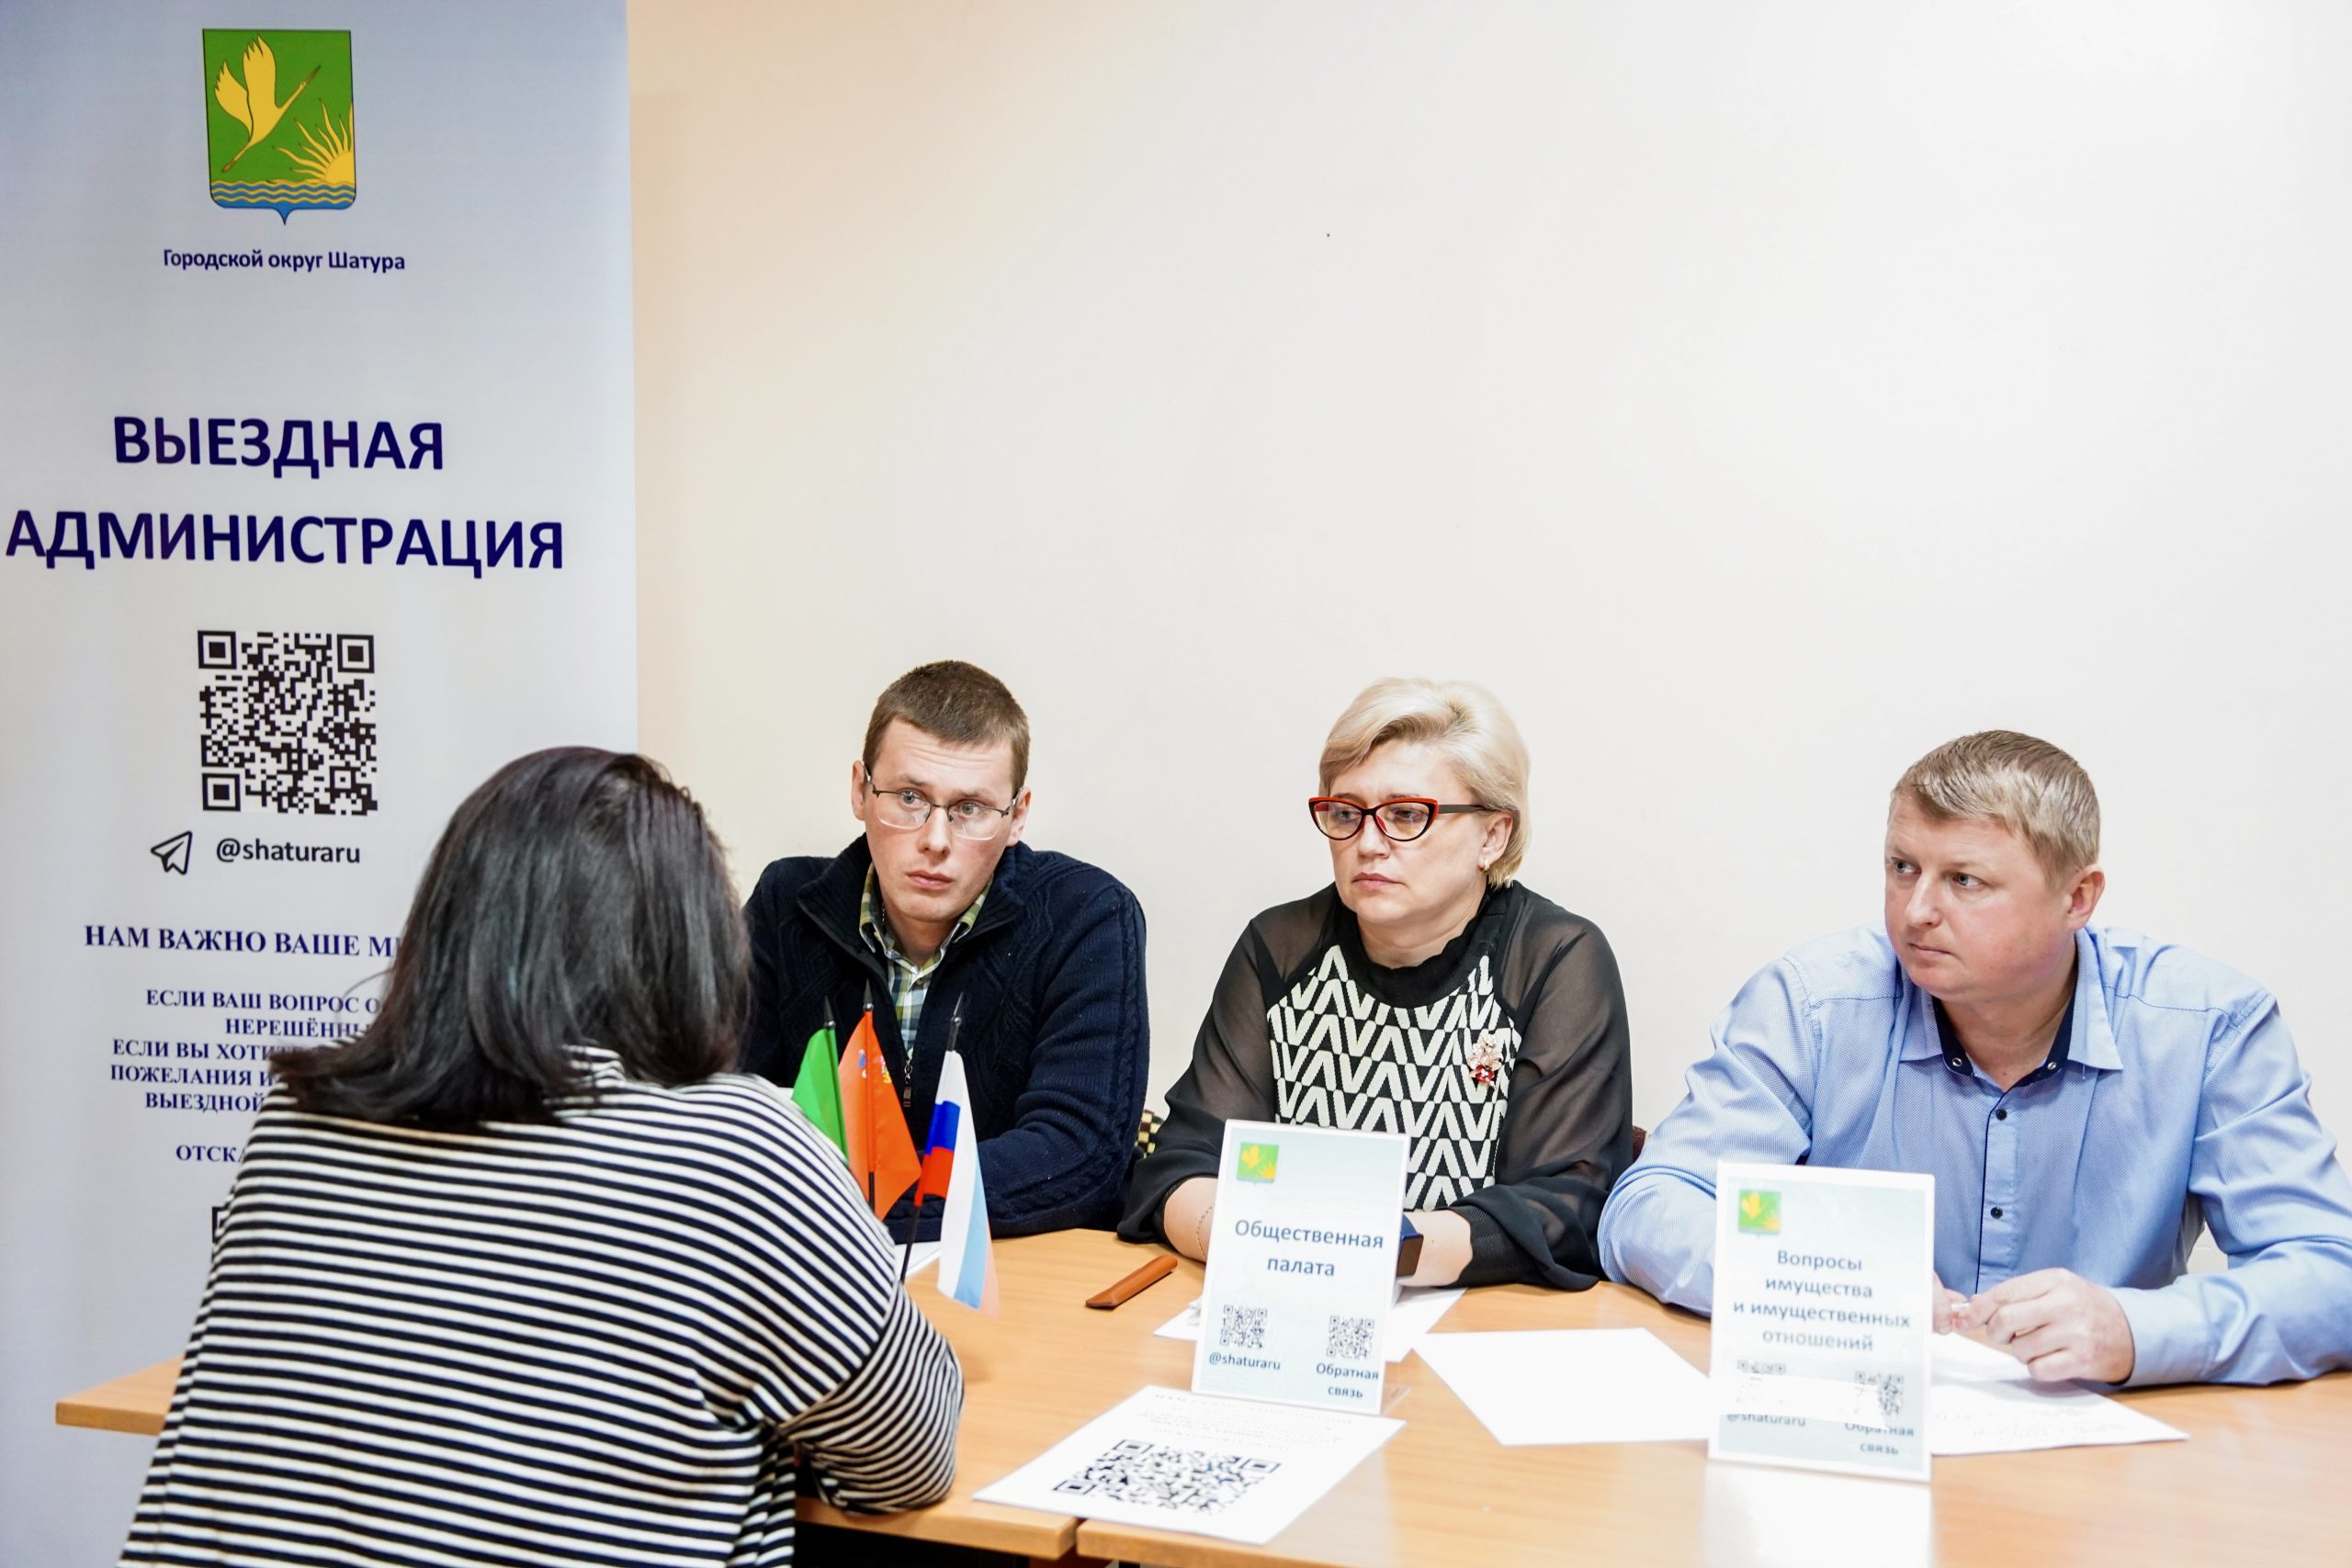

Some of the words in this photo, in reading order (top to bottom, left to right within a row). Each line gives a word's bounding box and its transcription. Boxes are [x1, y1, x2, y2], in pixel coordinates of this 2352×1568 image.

[164, 249, 264, 271] Городской
[267, 254, 323, 273] округ
[328, 251, 405, 271] Шатура
[113, 415, 444, 480] ВЫЕЗДНАЯ
[5, 509, 563, 580] АДМИНИСТРАЦИЯ
[216, 837, 361, 863] @shaturaru
[85, 925, 149, 949] НАМ
[159, 928, 266, 953] ВАЖНО
[275, 932, 360, 956] ВАШЕ
[146, 989, 205, 1008] ЕСЛИ
[212, 991, 262, 1010] ВАШ
[269, 994, 359, 1013] ВОПРОС
[113, 1038, 169, 1057] ЕСЛИ
[176, 1042, 209, 1059] ВЫ
[110, 1065, 253, 1087] ПОЖЕЛАНИЯ
[145, 1091, 266, 1113] ВЫЕЗДНОЙ
[1235, 1219, 1384, 1249] Общественная
[1267, 1258, 1335, 1277] палата
[1777, 1249, 1862, 1271] Вопросы
[1765, 1278, 1873, 1299] имущества
[1733, 1302, 1745, 1314] и
[1750, 1303, 1910, 1328] имущественных
[1761, 1329, 1873, 1351] отношений
[1208, 1351, 1281, 1371] @shaturaru
[1317, 1363, 1379, 1381] Обратная
[1328, 1386, 1363, 1398] связь
[1860, 1442, 1900, 1455] связь
